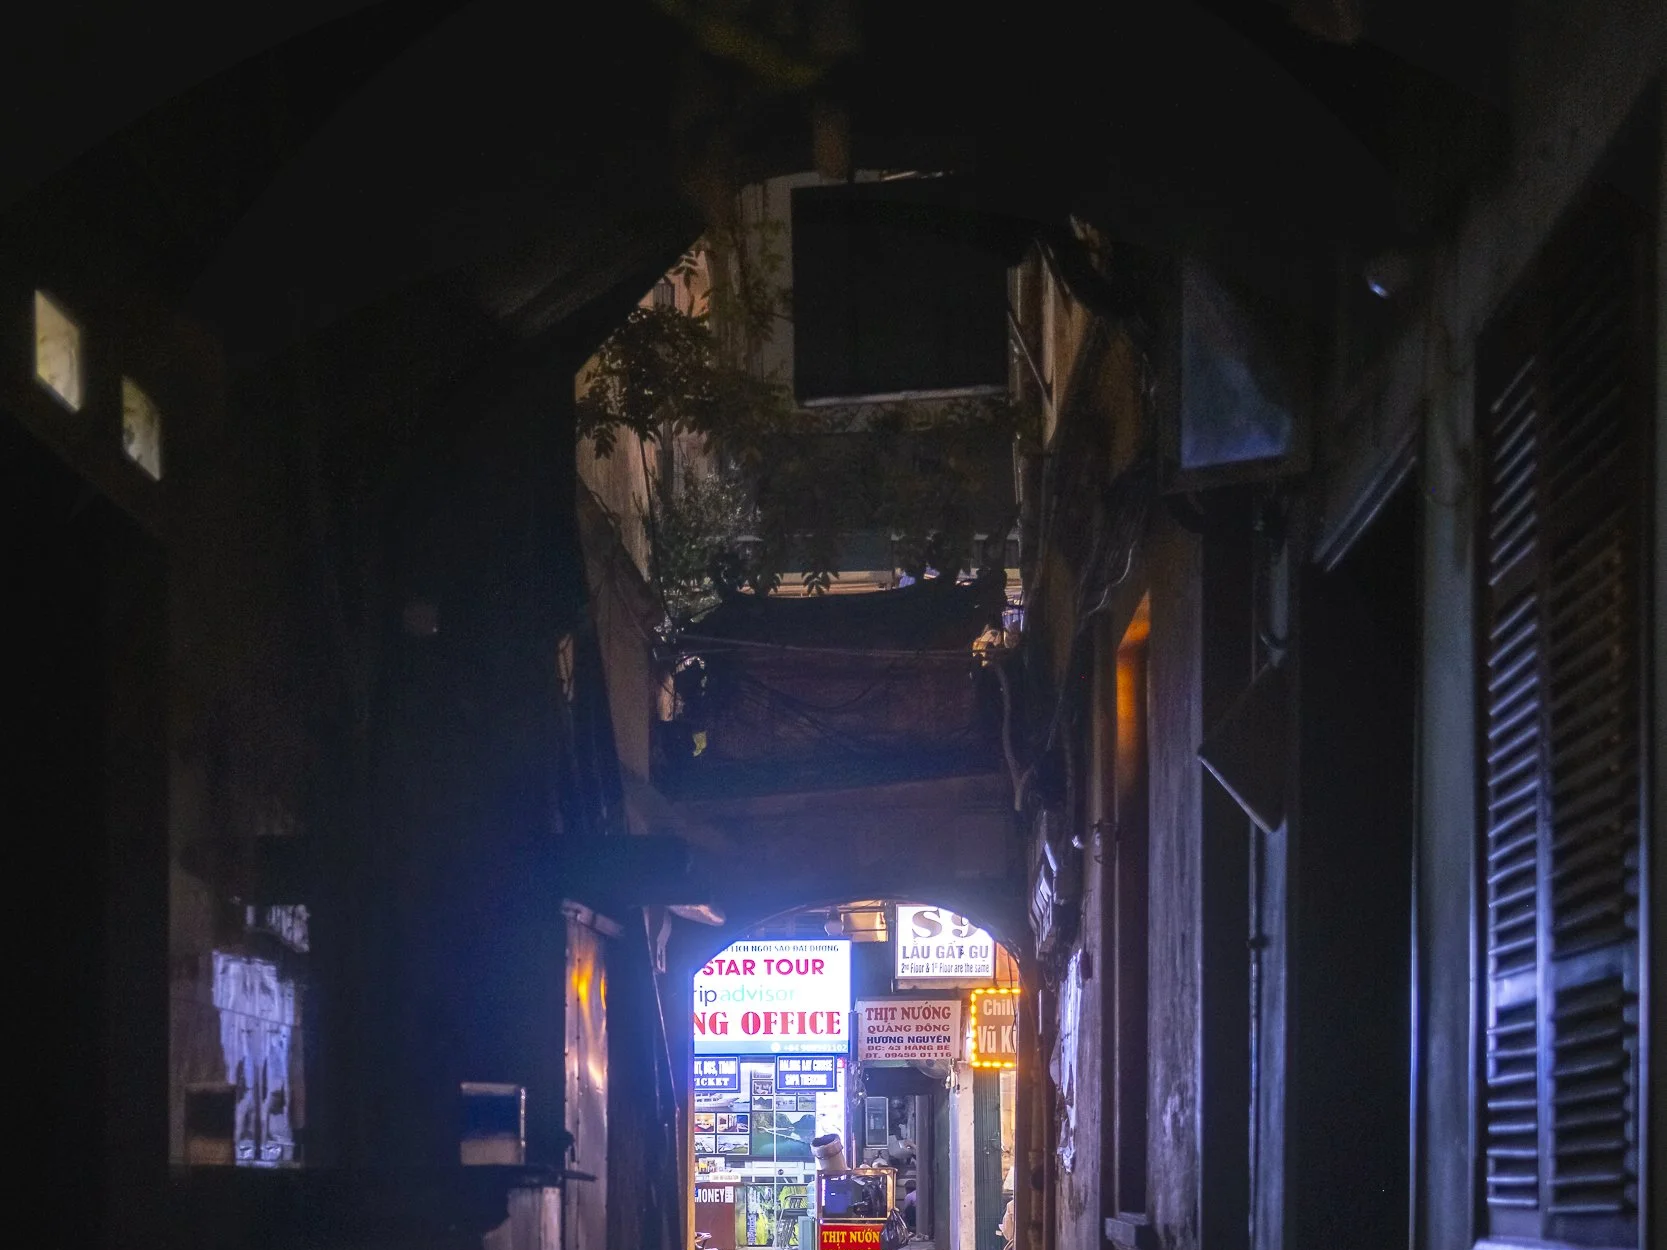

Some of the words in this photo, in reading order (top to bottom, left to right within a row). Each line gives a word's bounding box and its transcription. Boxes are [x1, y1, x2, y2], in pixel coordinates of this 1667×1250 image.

[702, 959, 756, 976] STAR
[763, 959, 825, 976] TOUR
[911, 963, 925, 974] Floor
[925, 963, 930, 974] &
[940, 963, 954, 974] Floor
[954, 964, 964, 974] are
[964, 963, 974, 974] the
[975, 964, 989, 974] same
[865, 1006, 897, 1023] THỊT
[901, 1001, 951, 1020] NƯỚNG
[741, 1011, 841, 1036] OFFICE
[867, 1021, 912, 1034] QUẢNG
[915, 1022, 950, 1032] ĐÔNG
[866, 1035, 904, 1044] HƯƠNG
[907, 1034, 951, 1044] NGUYÊN
[977, 1025, 997, 1054] Vũ
[822, 1231, 847, 1246] THỊT
[849, 1228, 881, 1243] NƯỚN
